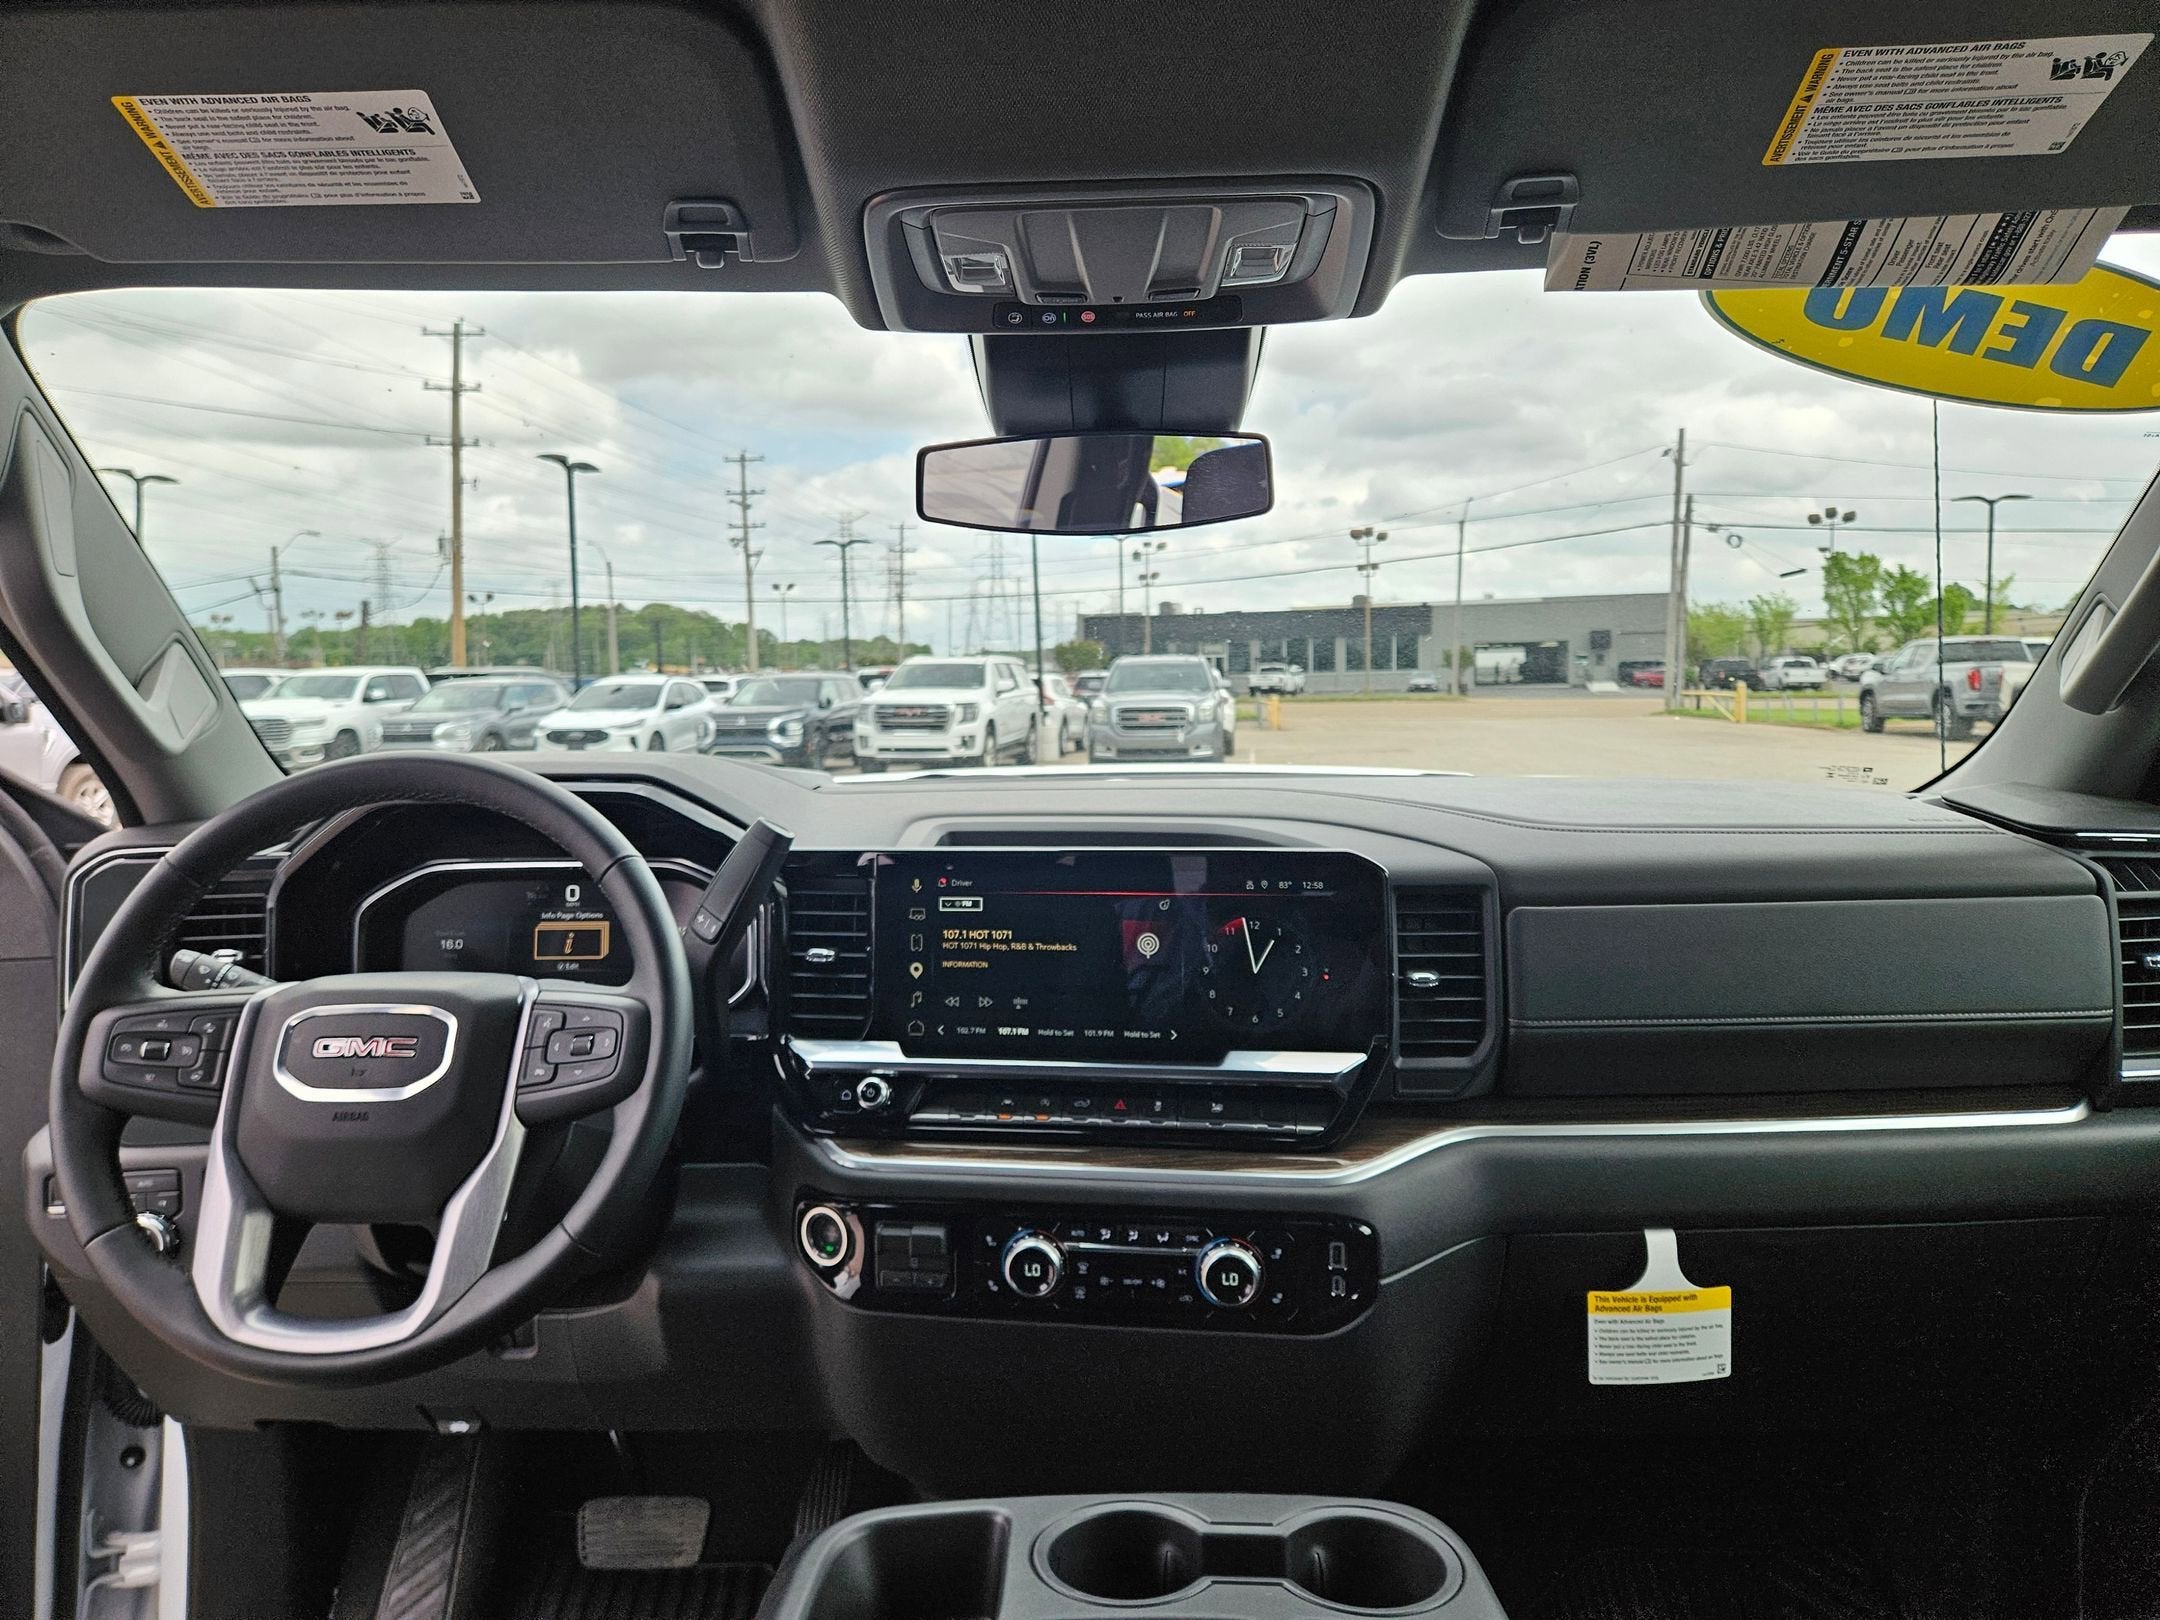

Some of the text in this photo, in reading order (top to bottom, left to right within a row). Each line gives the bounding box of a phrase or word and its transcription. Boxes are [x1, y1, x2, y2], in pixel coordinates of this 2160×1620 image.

[1842, 42, 2027, 57] EVEN WITH ADVANCED AIR BAGS
[1804, 53, 1835, 92] WARNING
[198, 96, 259, 104] ADVANCED
[1812, 95, 2065, 113] MÊME AVEC DES SACS GONFLABLES INTELLIGENTS
[119, 101, 158, 137] WARNING
[1769, 103, 1808, 161] AVERTISSEMENT
[180, 152, 214, 160] MÊME
[286, 149, 350, 157] GONFLABLES
[348, 147, 416, 156] INTELLIGENTS
[157, 149, 211, 205] AVERTISSEMENT
[1838, 226, 1859, 254] 5-STAR
[1990, 224, 2017, 259] Traffic Safety
[1585, 240, 1603, 267] (3VL)
[1896, 239, 1914, 266] Passenger
[2013, 224, 2050, 273] drives start with
[2029, 229, 2057, 266] Activate today
[1757, 234, 1782, 278] ALUMINUM WHEELS
[1888, 250, 1900, 265] Driver
[1924, 241, 1945, 268] Front seat
[1931, 243, 1952, 268] Rear seat
[1686, 249, 1701, 274] STANDARD
[1704, 249, 1720, 275] OPTIONS
[1278, 880, 1293, 889] 83°
[1302, 881, 1324, 890] 12:58
[565, 884, 580, 902] 0
[556, 912, 574, 921] Page
[576, 912, 604, 920] Options
[1224, 928, 1235, 936] 11
[1250, 922, 1260, 930] 12
[1277, 928, 1282, 936] 1
[942, 930, 1012, 939] 107.1 HOT 1071
[960, 942, 978, 950] 1071
[980, 943, 991, 951] Hip
[1206, 944, 1218, 952] 10
[1296, 945, 1301, 953] 2
[1202, 967, 1209, 975] 9
[1301, 968, 1308, 976] 3
[1209, 990, 1216, 999] 8
[1294, 992, 1301, 1000] 4
[1227, 1007, 1234, 1016] 7
[1277, 1008, 1284, 1017] 5
[1252, 1015, 1259, 1023] 6
[998, 1027, 1029, 1035] 107.1 FM
[1124, 1030, 1140, 1038] Hold
[312, 1037, 418, 1058] GMC
[1024, 1262, 1042, 1278] LO
[1222, 1271, 1240, 1288] LO
[1612, 1295, 1638, 1303] Vehicle
[1649, 1295, 1681, 1304] Equipped
[1645, 1304, 1663, 1313] Bags
